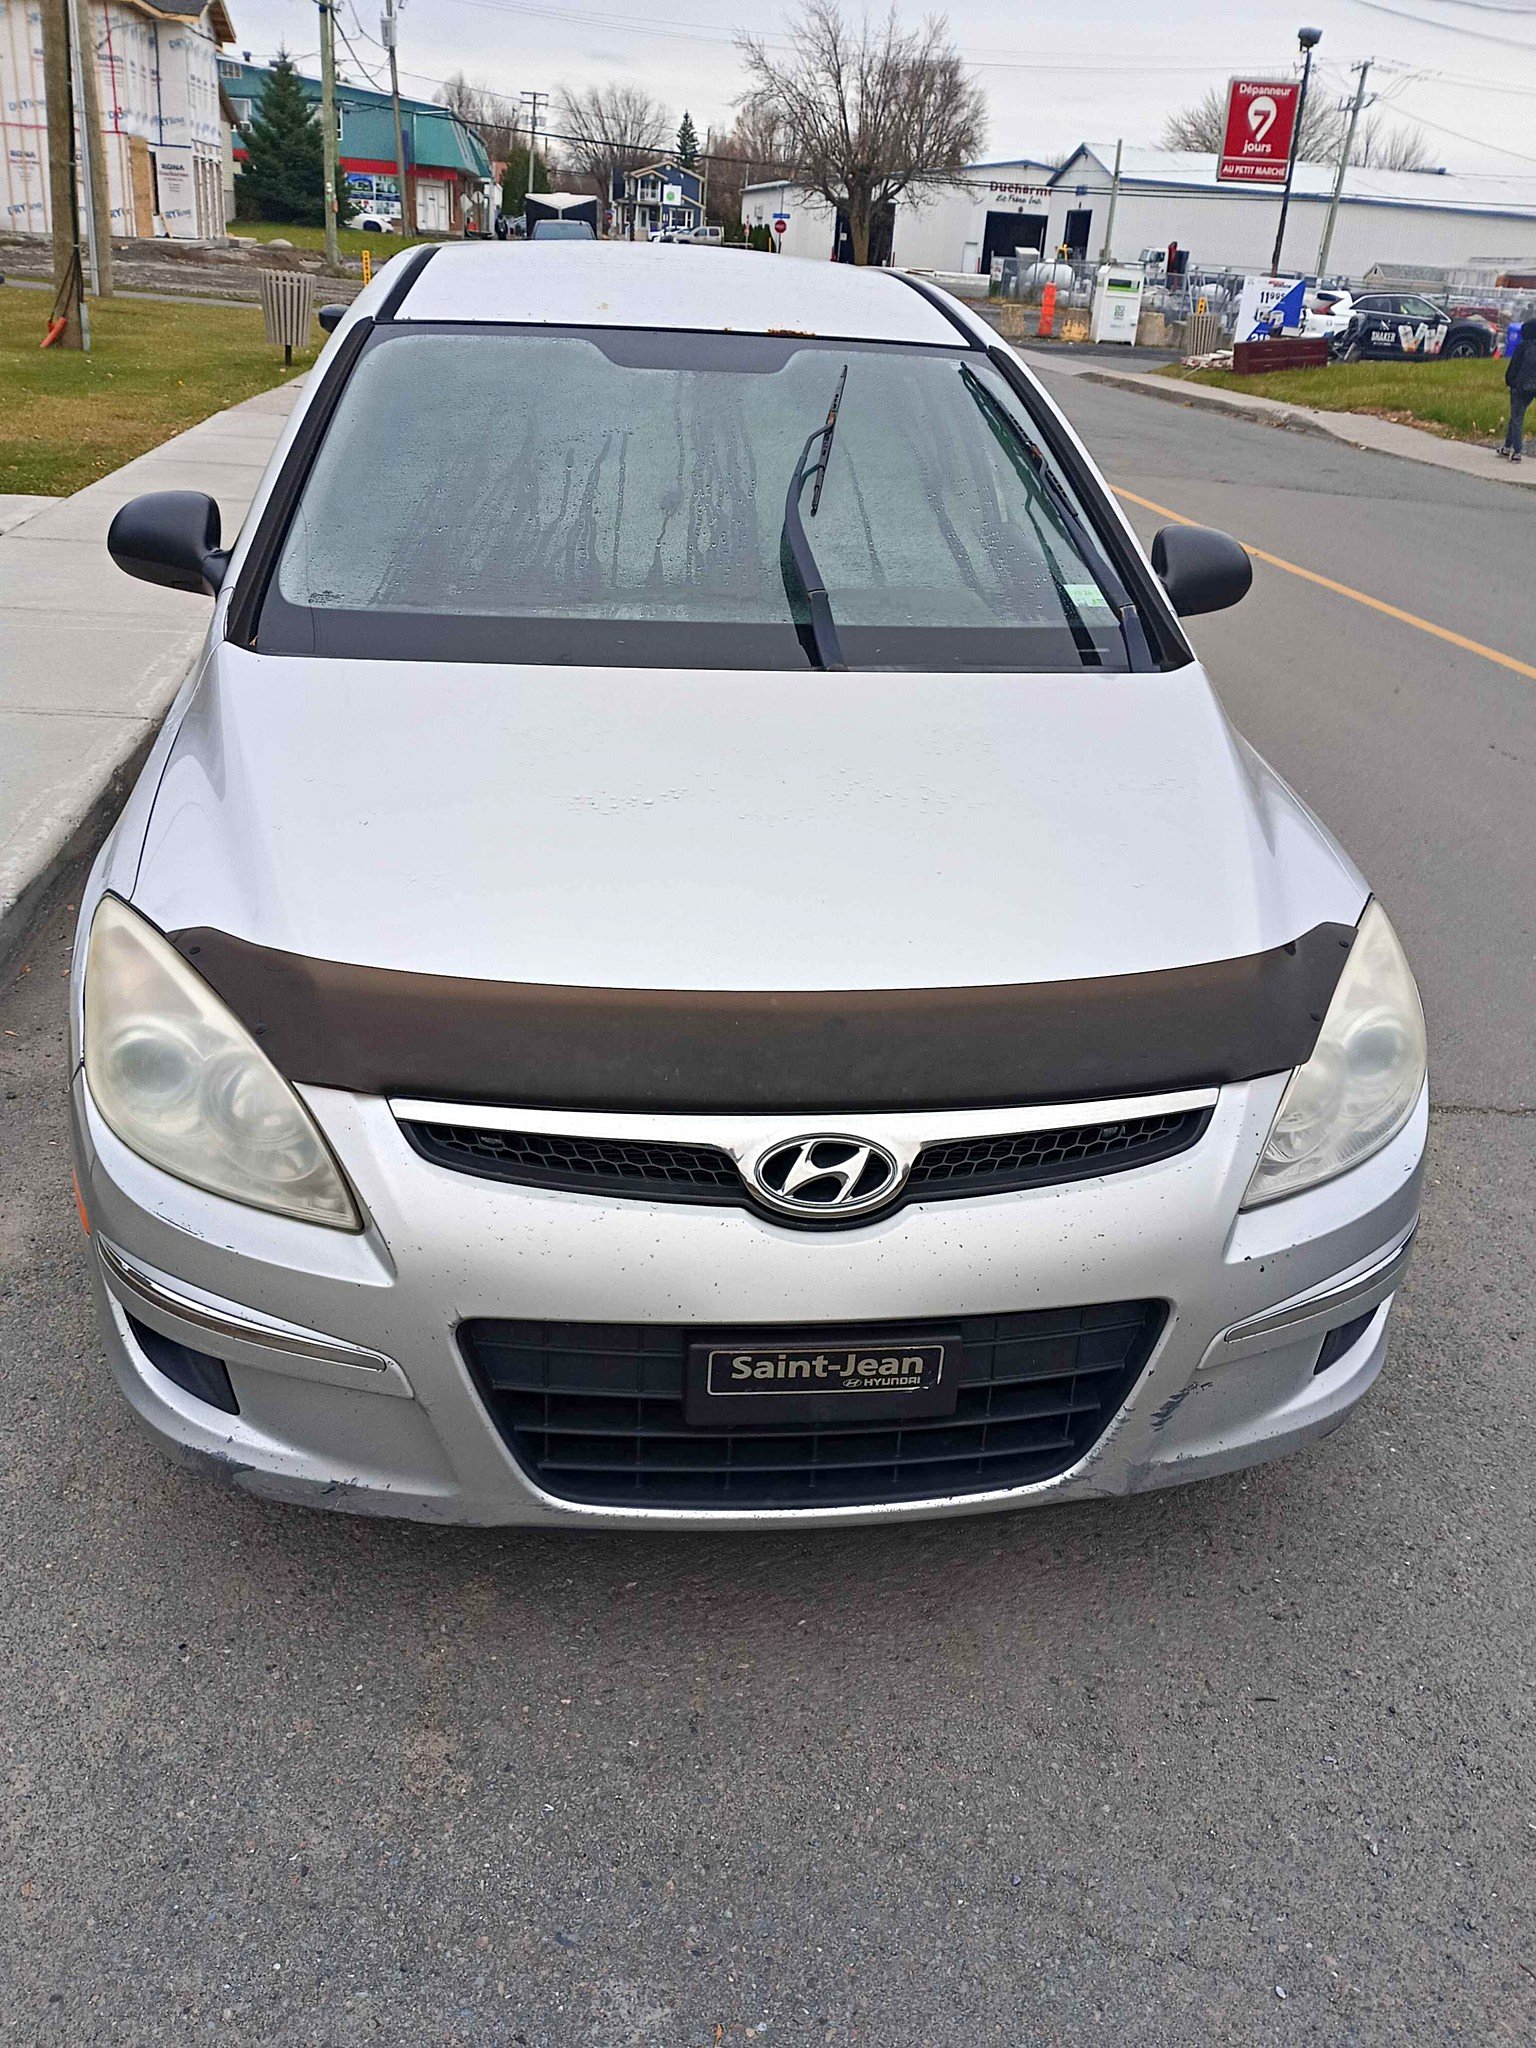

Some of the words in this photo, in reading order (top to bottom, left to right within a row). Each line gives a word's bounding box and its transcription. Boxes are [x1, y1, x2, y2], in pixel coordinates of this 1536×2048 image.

[1239, 83, 1291, 96] Dépanneur
[1242, 139, 1272, 154] jours
[1223, 164, 1234, 173] AU
[1235, 165, 1254, 175] PETIT
[1371, 331, 1396, 342] SHAKER
[731, 1354, 924, 1379] Saint-Jean
[863, 1377, 921, 1387] HYUNDAI
